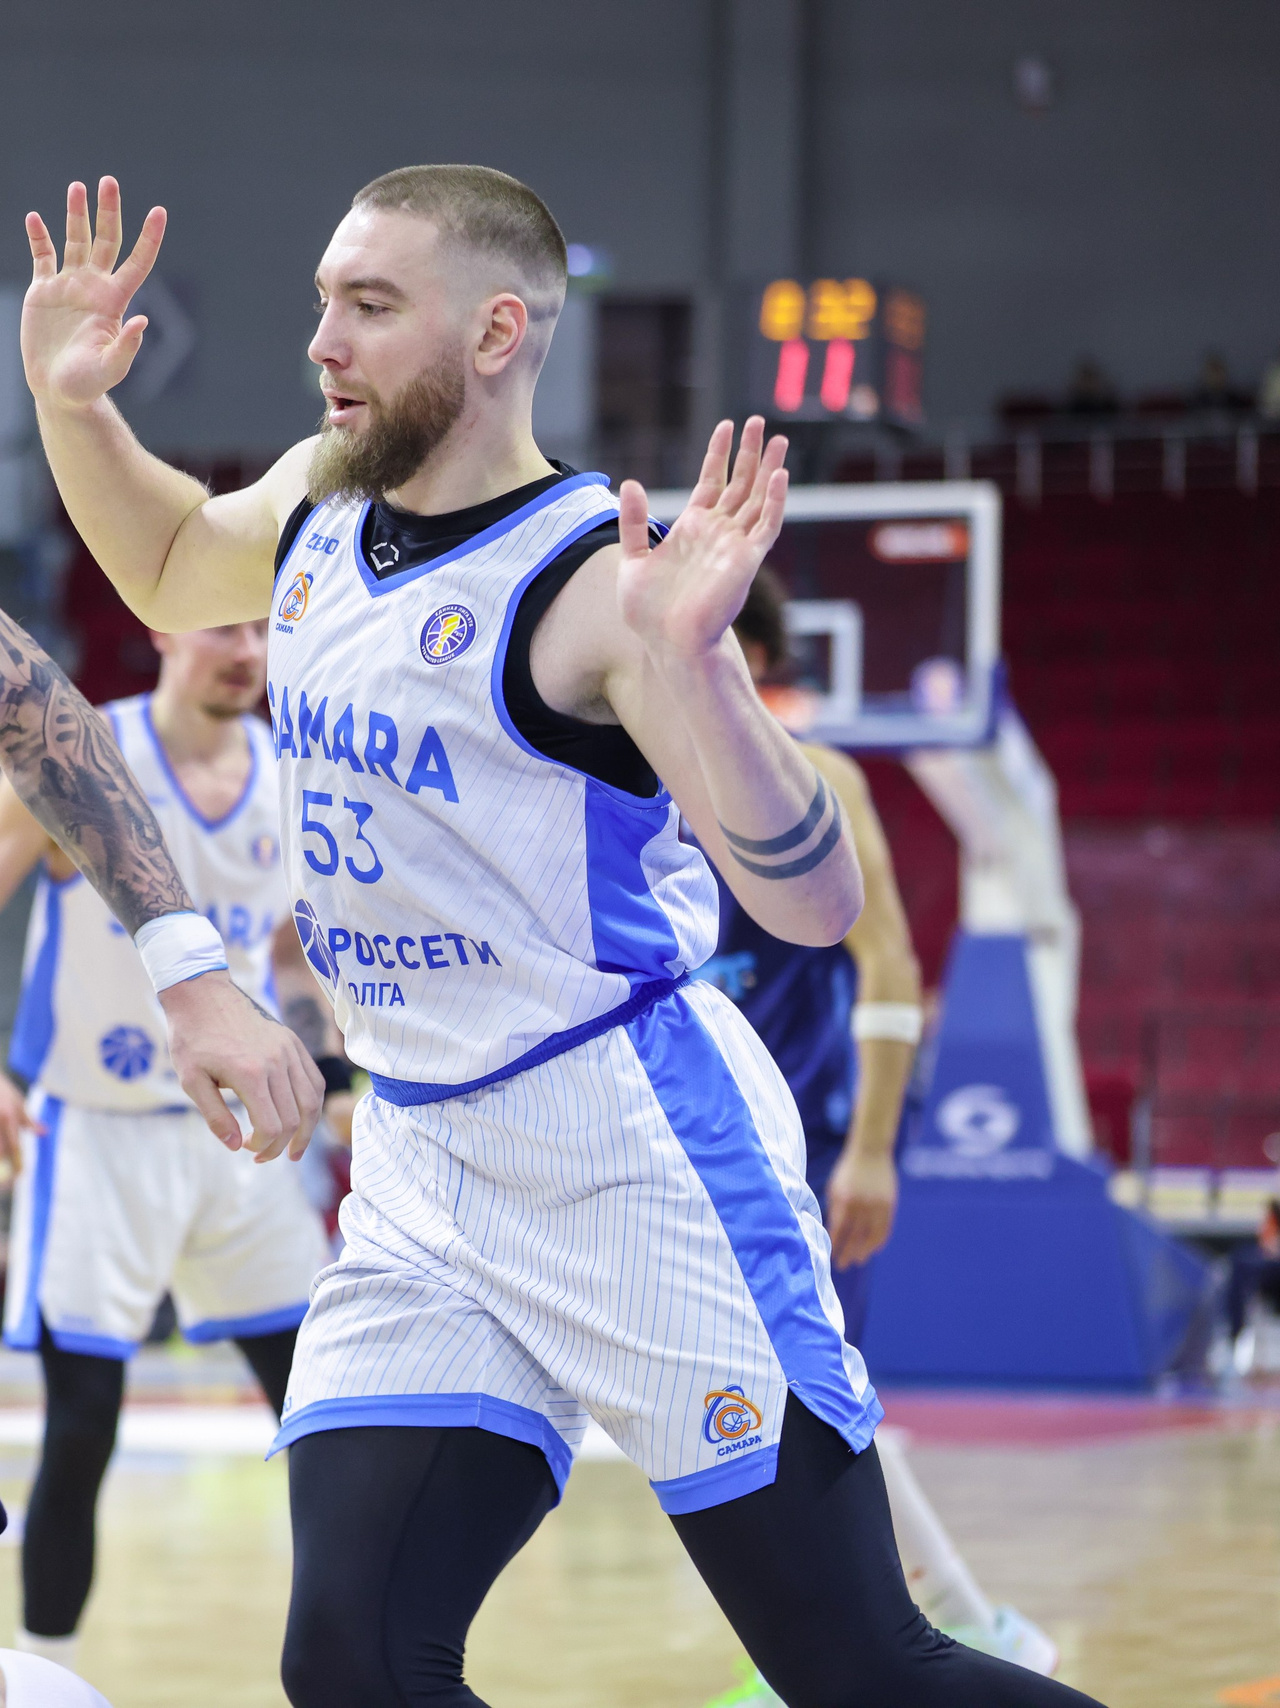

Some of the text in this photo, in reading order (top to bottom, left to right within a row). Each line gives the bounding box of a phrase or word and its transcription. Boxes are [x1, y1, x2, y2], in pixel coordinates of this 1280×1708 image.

[302, 790, 383, 884] 53
[328, 928, 502, 970] РОССЕТИ
[717, 1435, 762, 1457] САМАРА
